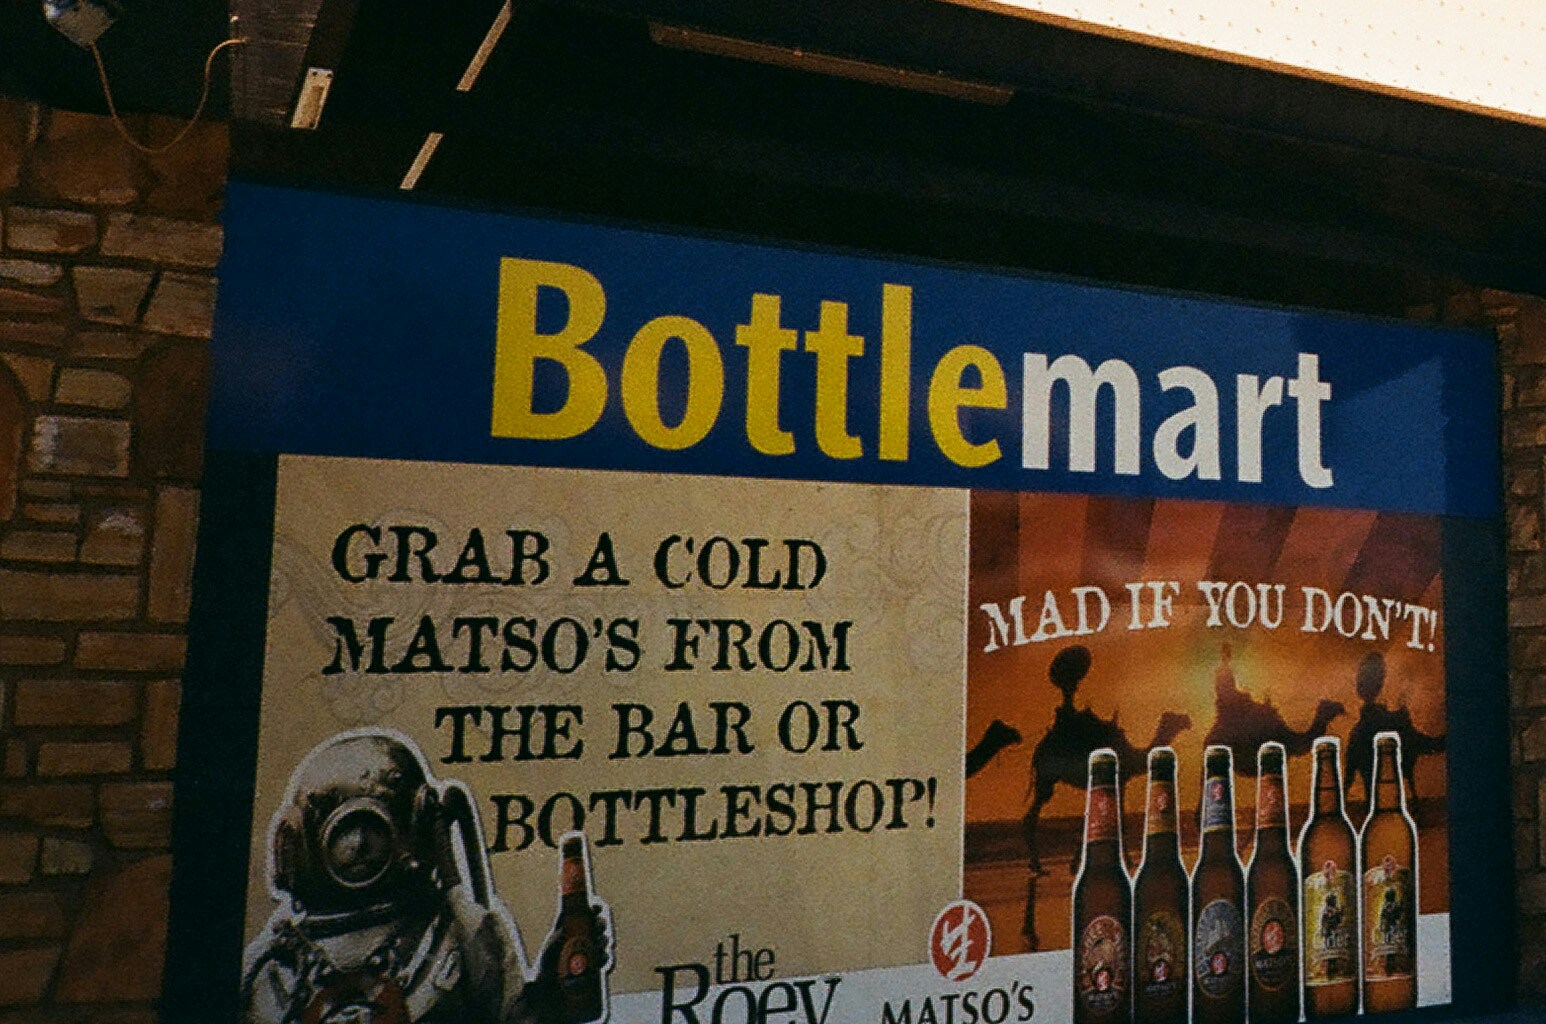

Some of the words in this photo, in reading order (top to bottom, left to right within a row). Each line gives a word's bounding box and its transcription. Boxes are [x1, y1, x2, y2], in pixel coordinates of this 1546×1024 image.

[490, 255, 1335, 489] Bottlemart
[330, 524, 551, 587] GRAB
[572, 531, 630, 588] A
[652, 533, 828, 591] COLD
[321, 615, 642, 677] MATSO'S
[664, 617, 854, 674] FROM
[979, 583, 1111, 653] MAD
[1124, 580, 1181, 631] IF
[1198, 580, 1287, 630] YOU
[1300, 587, 1439, 653] DON'T!
[434, 704, 584, 764] THE
[608, 701, 755, 761] BAR
[778, 699, 864, 754] OR
[489, 777, 938, 854] BOTTLESHOP!
[713, 933, 776, 985] the
[881, 981, 1035, 1024] MATSO'S
